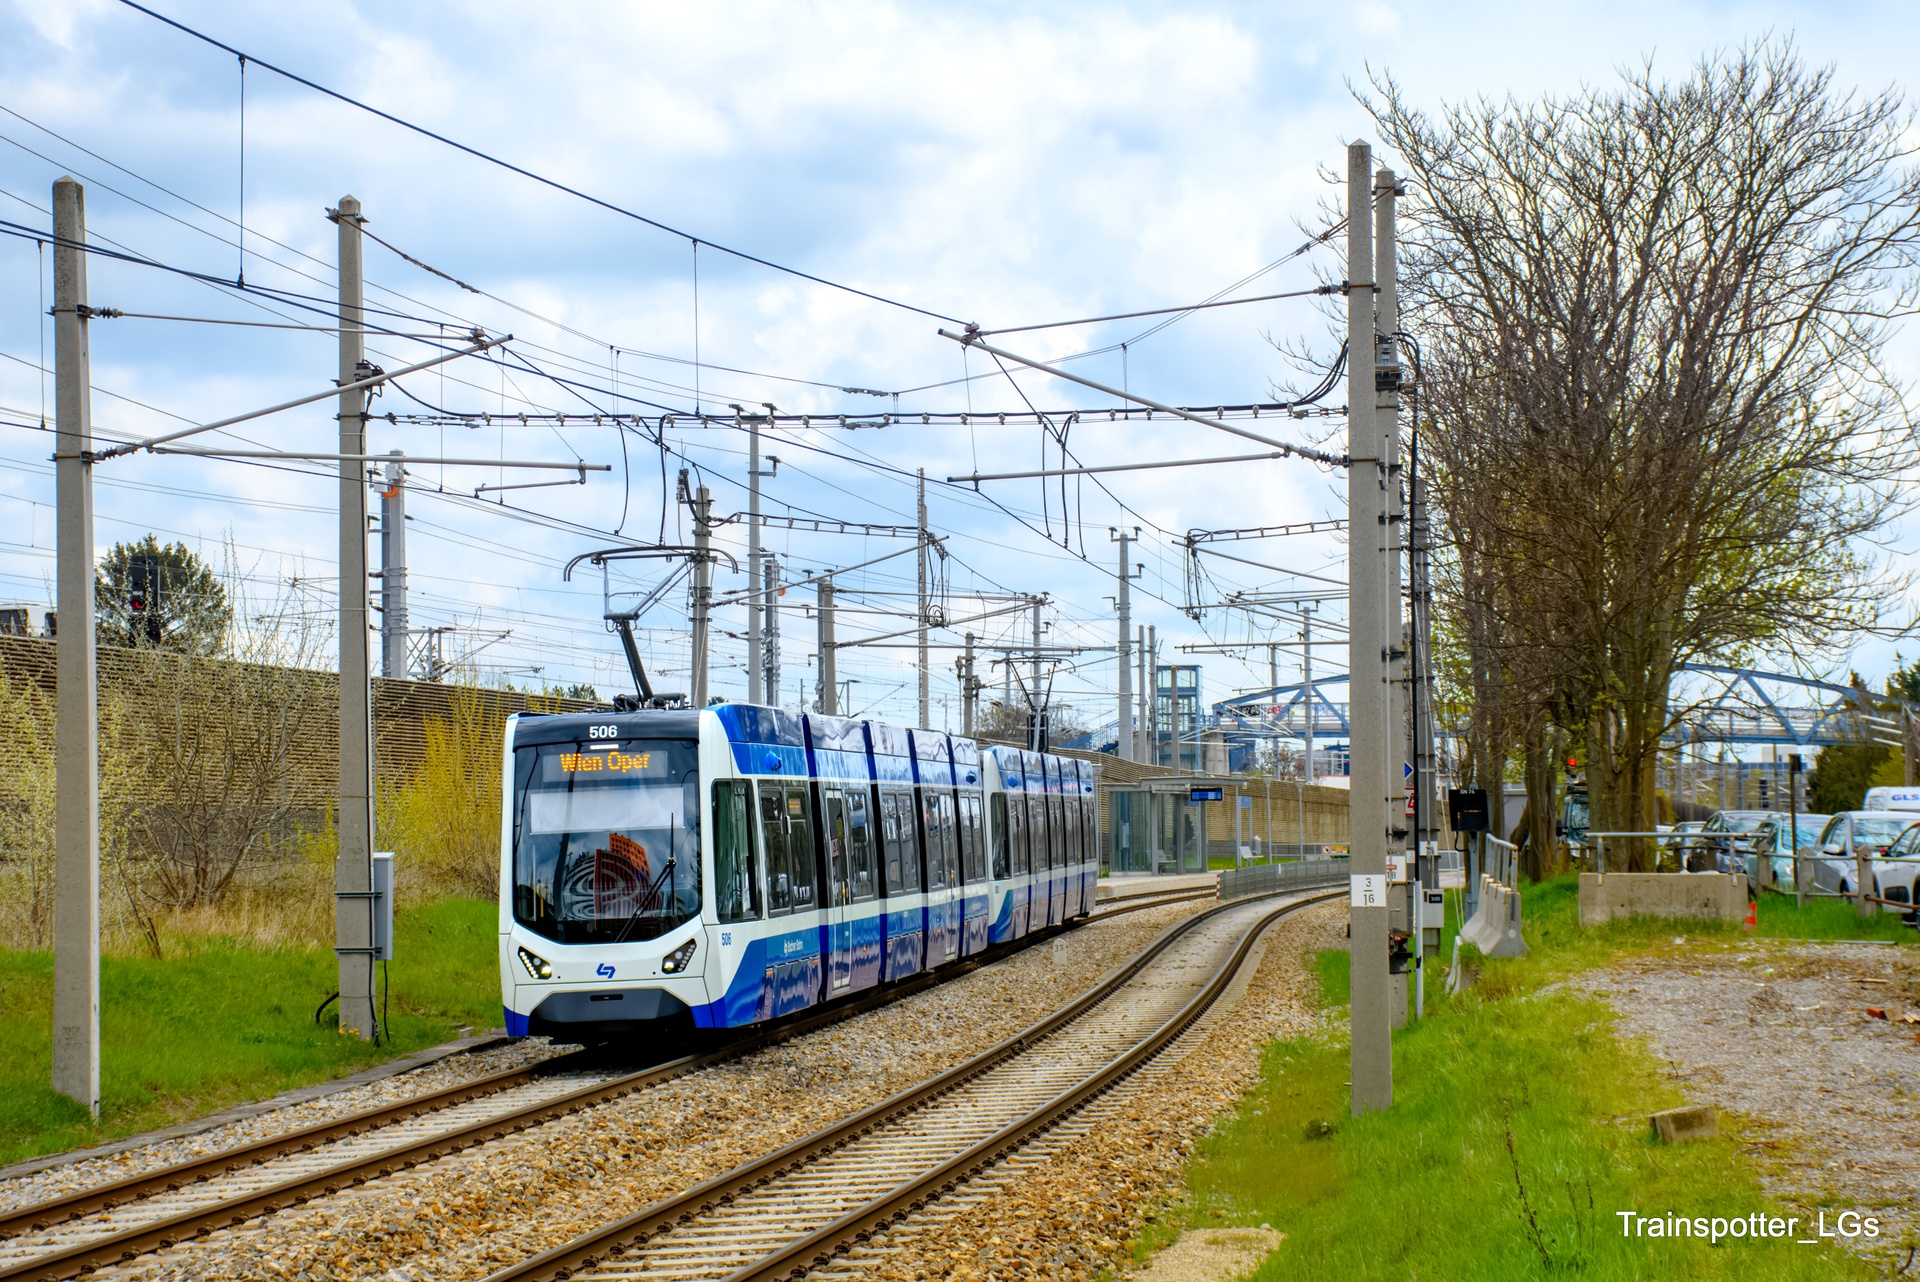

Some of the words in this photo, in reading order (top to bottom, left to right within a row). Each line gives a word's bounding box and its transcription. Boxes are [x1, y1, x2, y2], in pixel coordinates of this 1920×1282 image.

[589, 725, 618, 738] 506
[560, 753, 603, 772] Wien
[607, 751, 651, 773] Oper
[1365, 877, 1372, 887] 3
[1363, 893, 1375, 905] 16
[721, 932, 732, 946] 506
